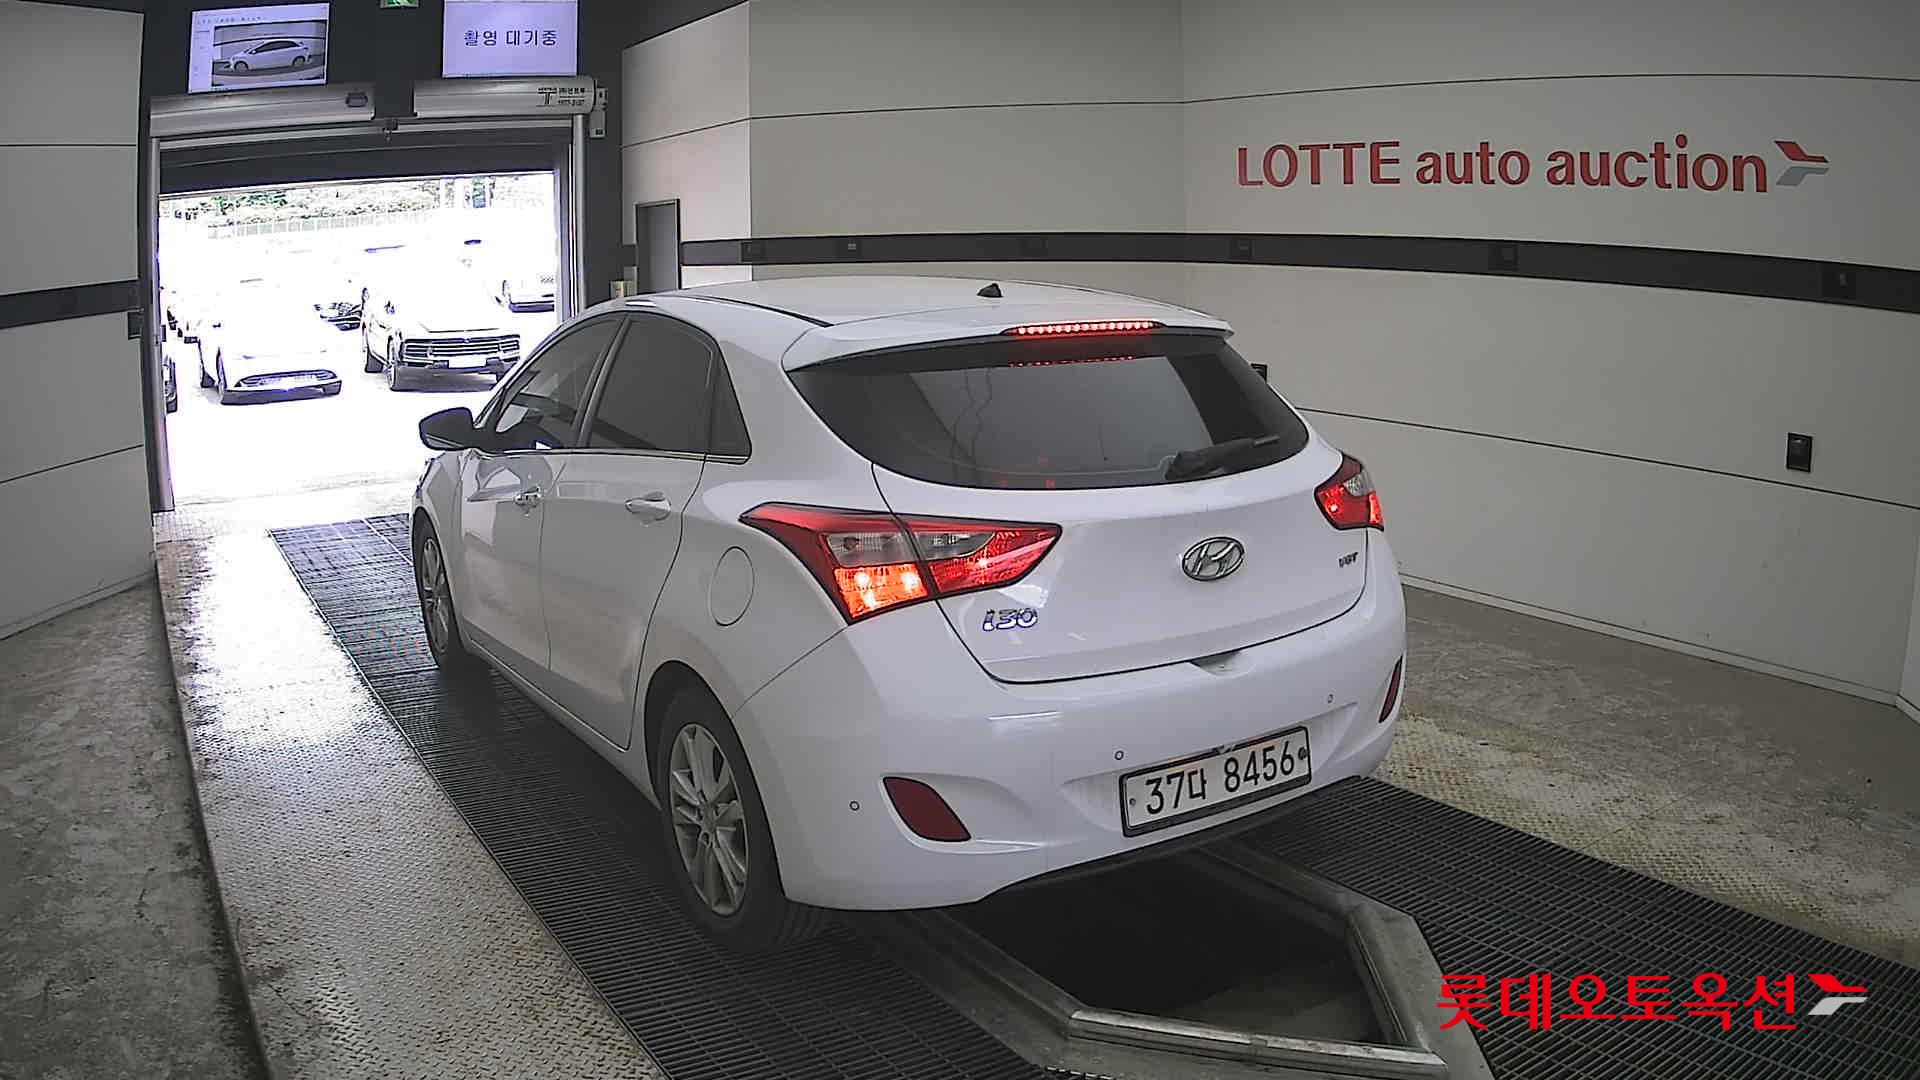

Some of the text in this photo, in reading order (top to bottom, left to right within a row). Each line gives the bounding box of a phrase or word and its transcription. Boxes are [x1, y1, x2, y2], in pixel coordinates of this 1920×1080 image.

[464, 30, 558, 47] 촬영 대기중
[1238, 134, 1768, 193] LOTTE auto auction
[982, 608, 1038, 632] i30
[1223, 741, 1295, 793] 8456
